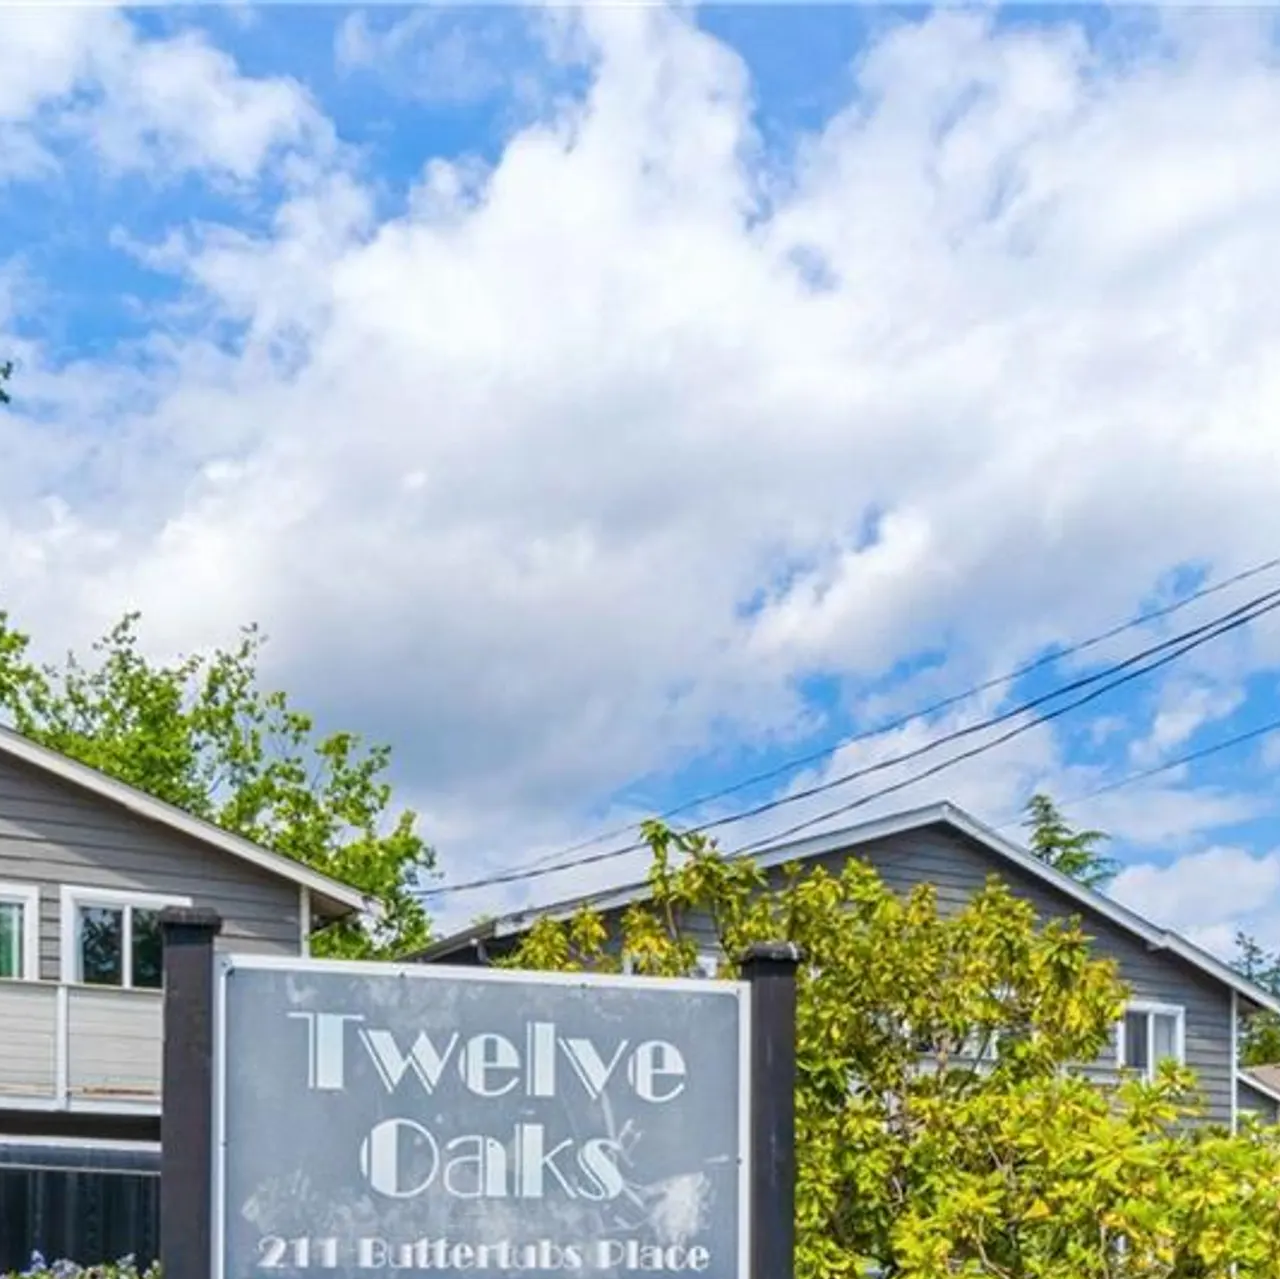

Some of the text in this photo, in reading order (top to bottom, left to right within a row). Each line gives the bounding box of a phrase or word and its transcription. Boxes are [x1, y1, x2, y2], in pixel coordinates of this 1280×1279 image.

[287, 1012, 687, 1103] Twelve
[360, 1117, 624, 1200] Oaks
[257, 1235, 710, 1272] 211 Buttertubs Place
